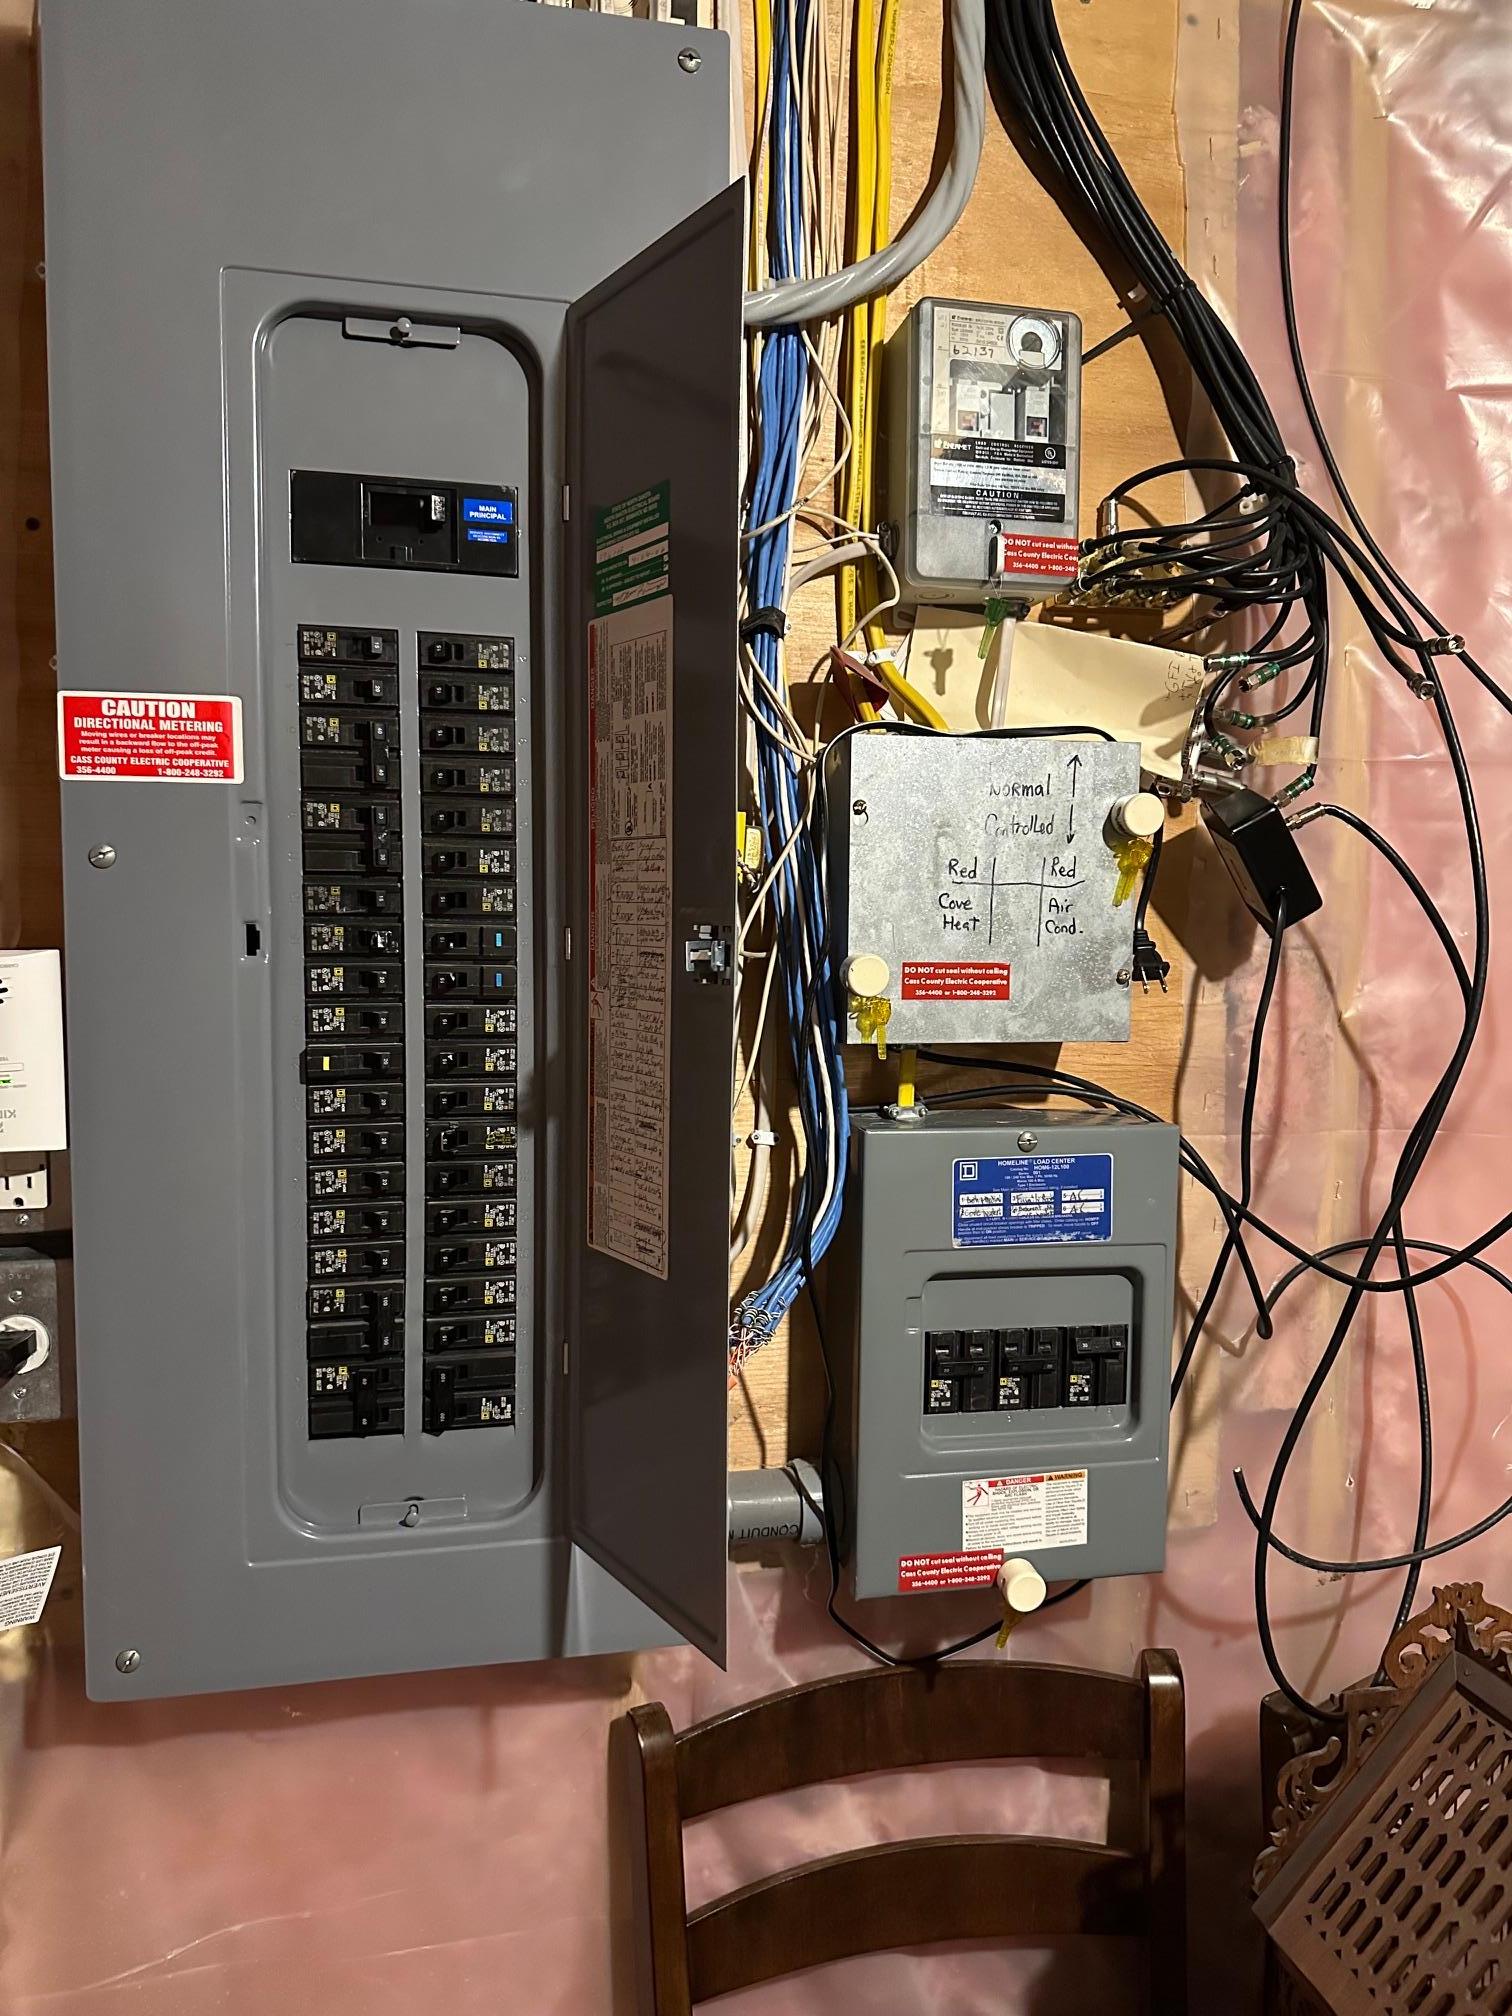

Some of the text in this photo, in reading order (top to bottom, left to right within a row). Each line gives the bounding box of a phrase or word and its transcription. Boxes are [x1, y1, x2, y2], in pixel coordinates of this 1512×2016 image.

[953, 345, 993, 358] 62137
[479, 504, 496, 512] MAIN
[469, 511, 507, 520] PRINCIPAL
[1015, 539, 1031, 547] NOT
[1018, 550, 1040, 559] County
[1041, 552, 1063, 560] Electric
[1013, 562, 1039, 570] 356-4400
[101, 698, 196, 719] CAUTION
[74, 717, 223, 733] DIRECTIONAL METERING
[80, 730, 107, 738] Moving
[138, 732, 166, 740] breaker
[167, 733, 200, 741] locations
[115, 739, 150, 747] backward
[103, 747, 131, 755] causing
[70, 755, 230, 767] CASS COUNTY ELECTRIC COOPERATIVE
[76, 766, 224, 777] 356-4400 1-800-248-3292
[949, 856, 1076, 879] Red Red
[939, 893, 1073, 913] Cove Air
[943, 915, 981, 931] Heat
[986, 967, 1008, 976] calling
[969, 978, 1007, 986] Cooperative
[1006, 1477, 1032, 1485] DANGER
[1054, 1472, 1083, 1480] WARNING
[738, 1524, 799, 1539] CONDUIT
[914, 1558, 930, 1567] NOT
[956, 1555, 979, 1563] without
[980, 1553, 1002, 1561] calling
[963, 1563, 1001, 1573] Cooperative
[912, 1579, 938, 1587] 356-4400
